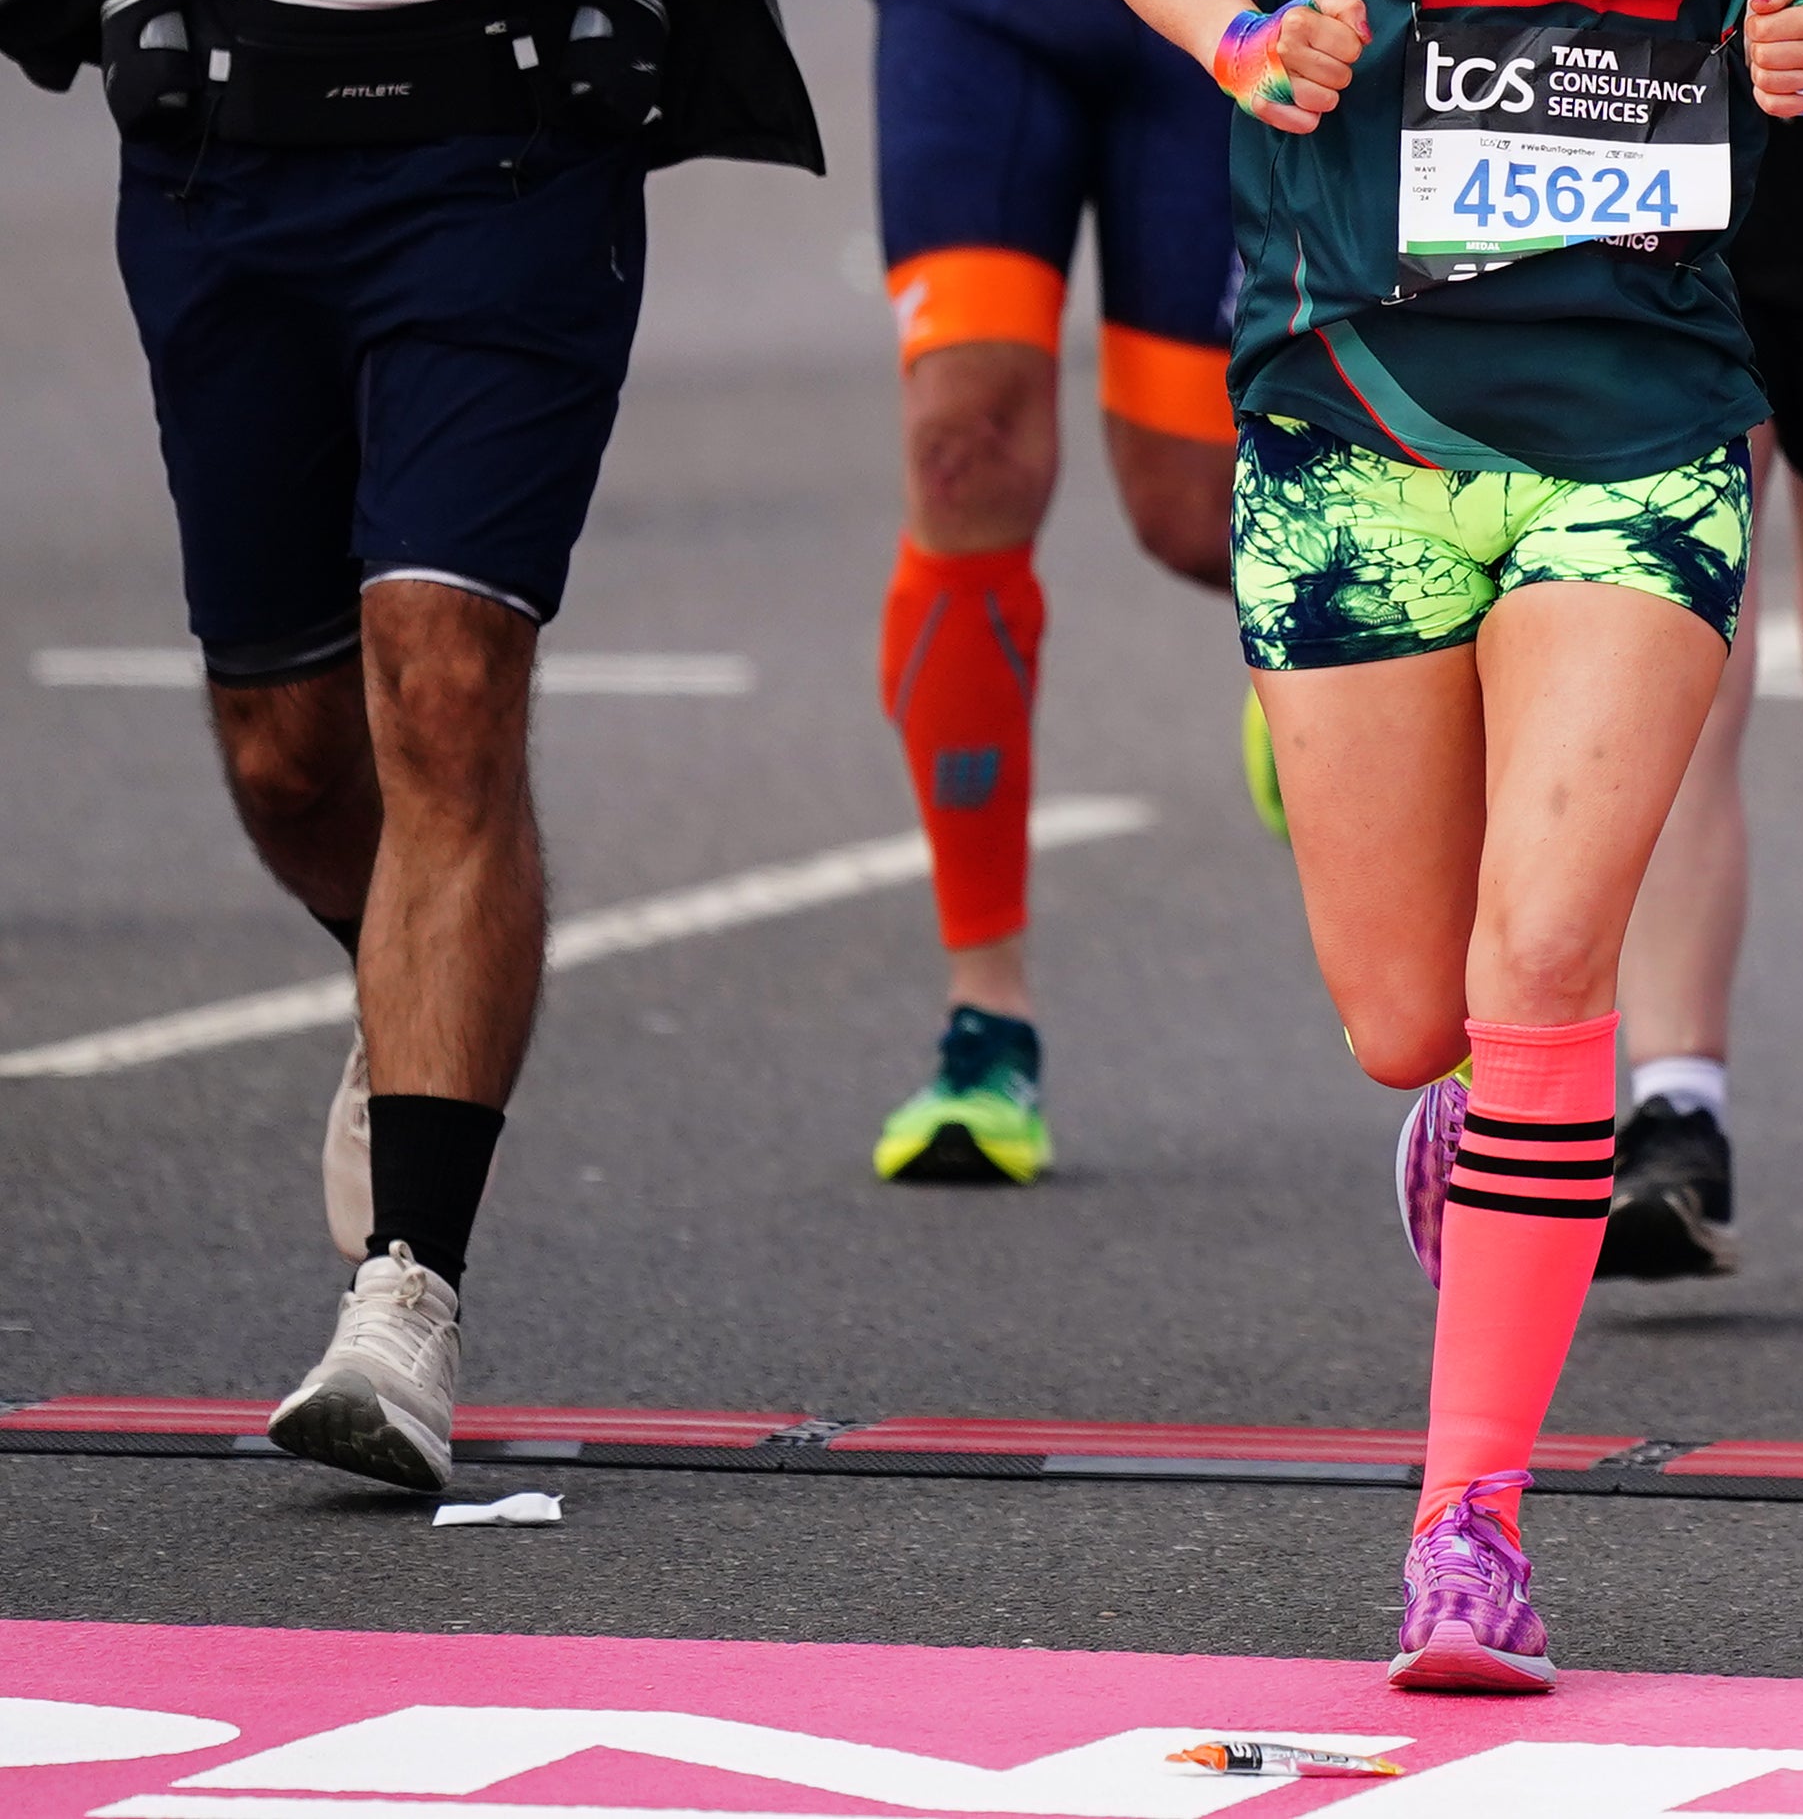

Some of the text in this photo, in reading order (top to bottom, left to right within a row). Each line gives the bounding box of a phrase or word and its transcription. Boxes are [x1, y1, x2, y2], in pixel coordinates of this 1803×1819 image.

[1551, 45, 1619, 71] TATA
[1424, 40, 1536, 113] tcs
[1548, 70, 1707, 105] CONSULTANCY
[341, 83, 413, 98] FITLETIC
[1547, 95, 1650, 124] SERVICES
[1520, 143, 1596, 157] #WeRunTogether
[1453, 158, 1678, 228] 45624
[1466, 241, 1500, 251] MEDAL
